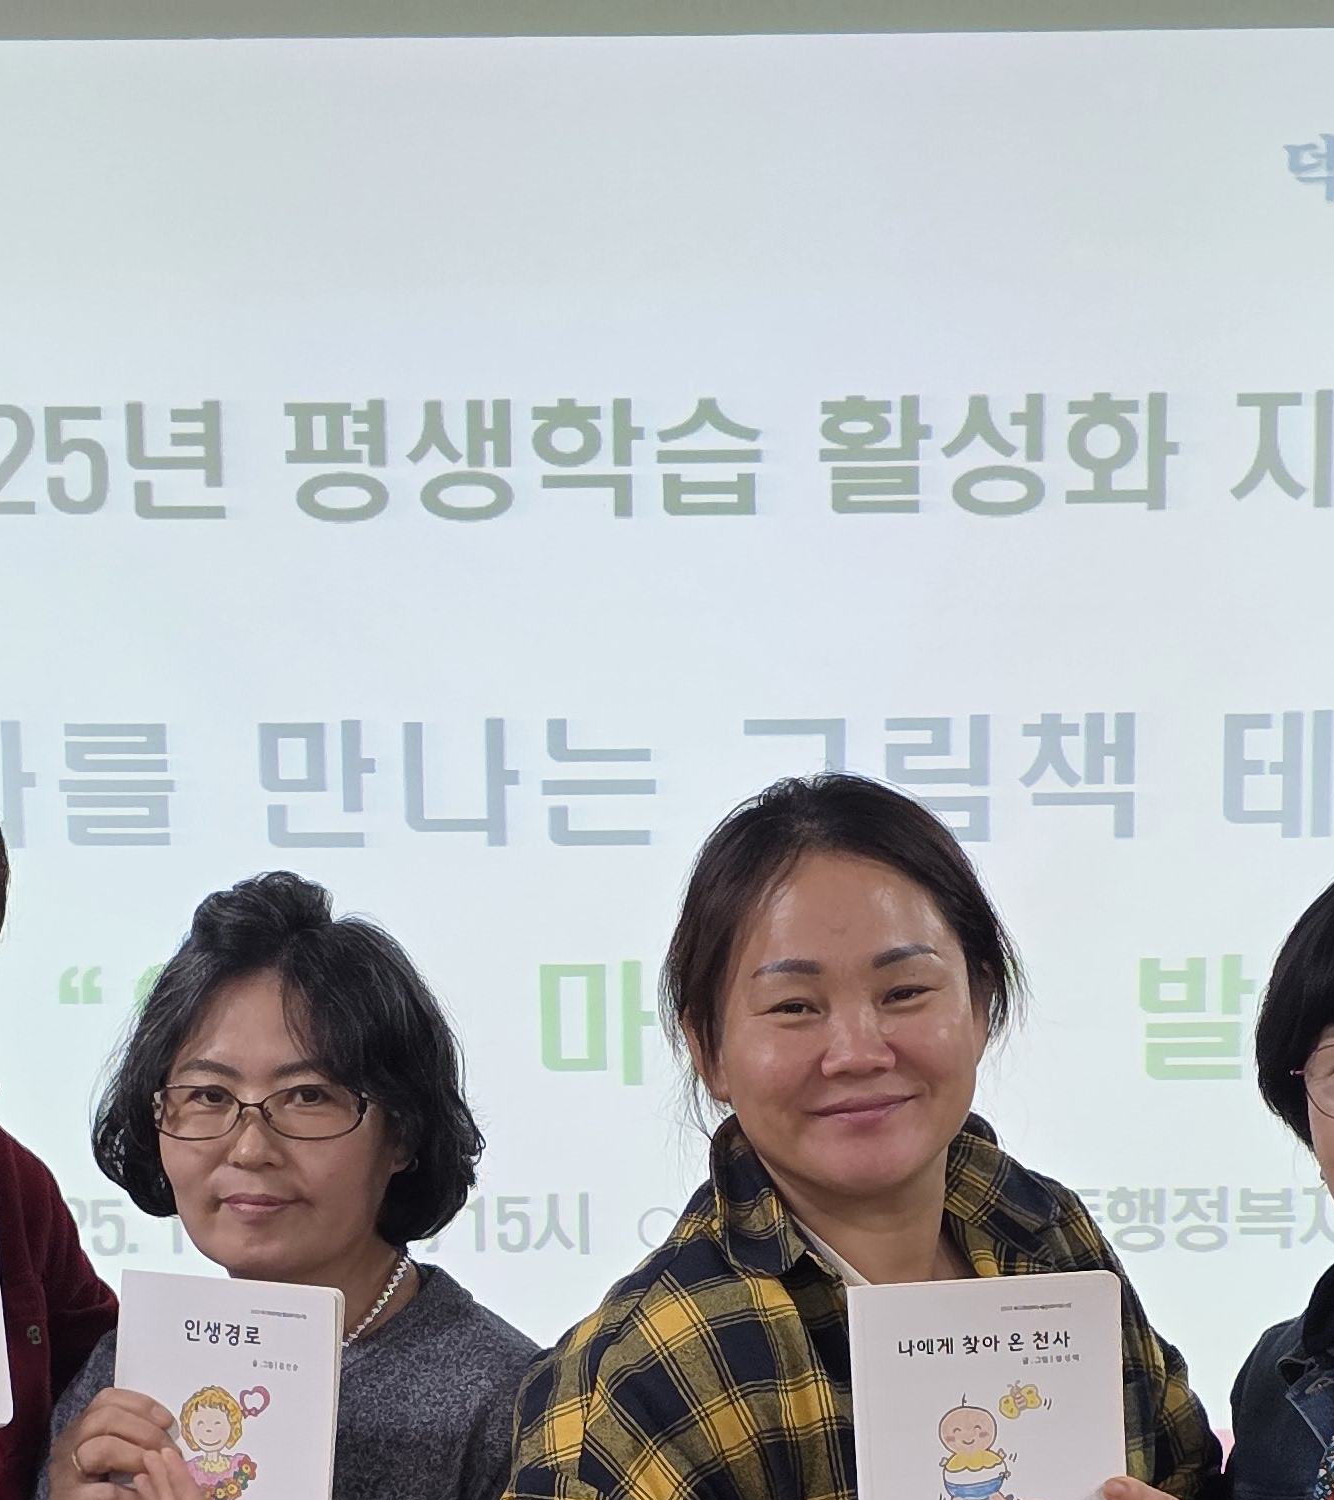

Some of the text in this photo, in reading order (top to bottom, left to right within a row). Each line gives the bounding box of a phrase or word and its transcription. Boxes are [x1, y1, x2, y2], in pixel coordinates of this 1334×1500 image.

[283, 397, 765, 523] 평생학습
[818, 392, 1180, 517] 활성화
[258, 717, 658, 848] 만나는
[184, 1319, 262, 1347] 인생경로
[898, 1330, 1071, 1357] 나에게 찾아 온 천사
